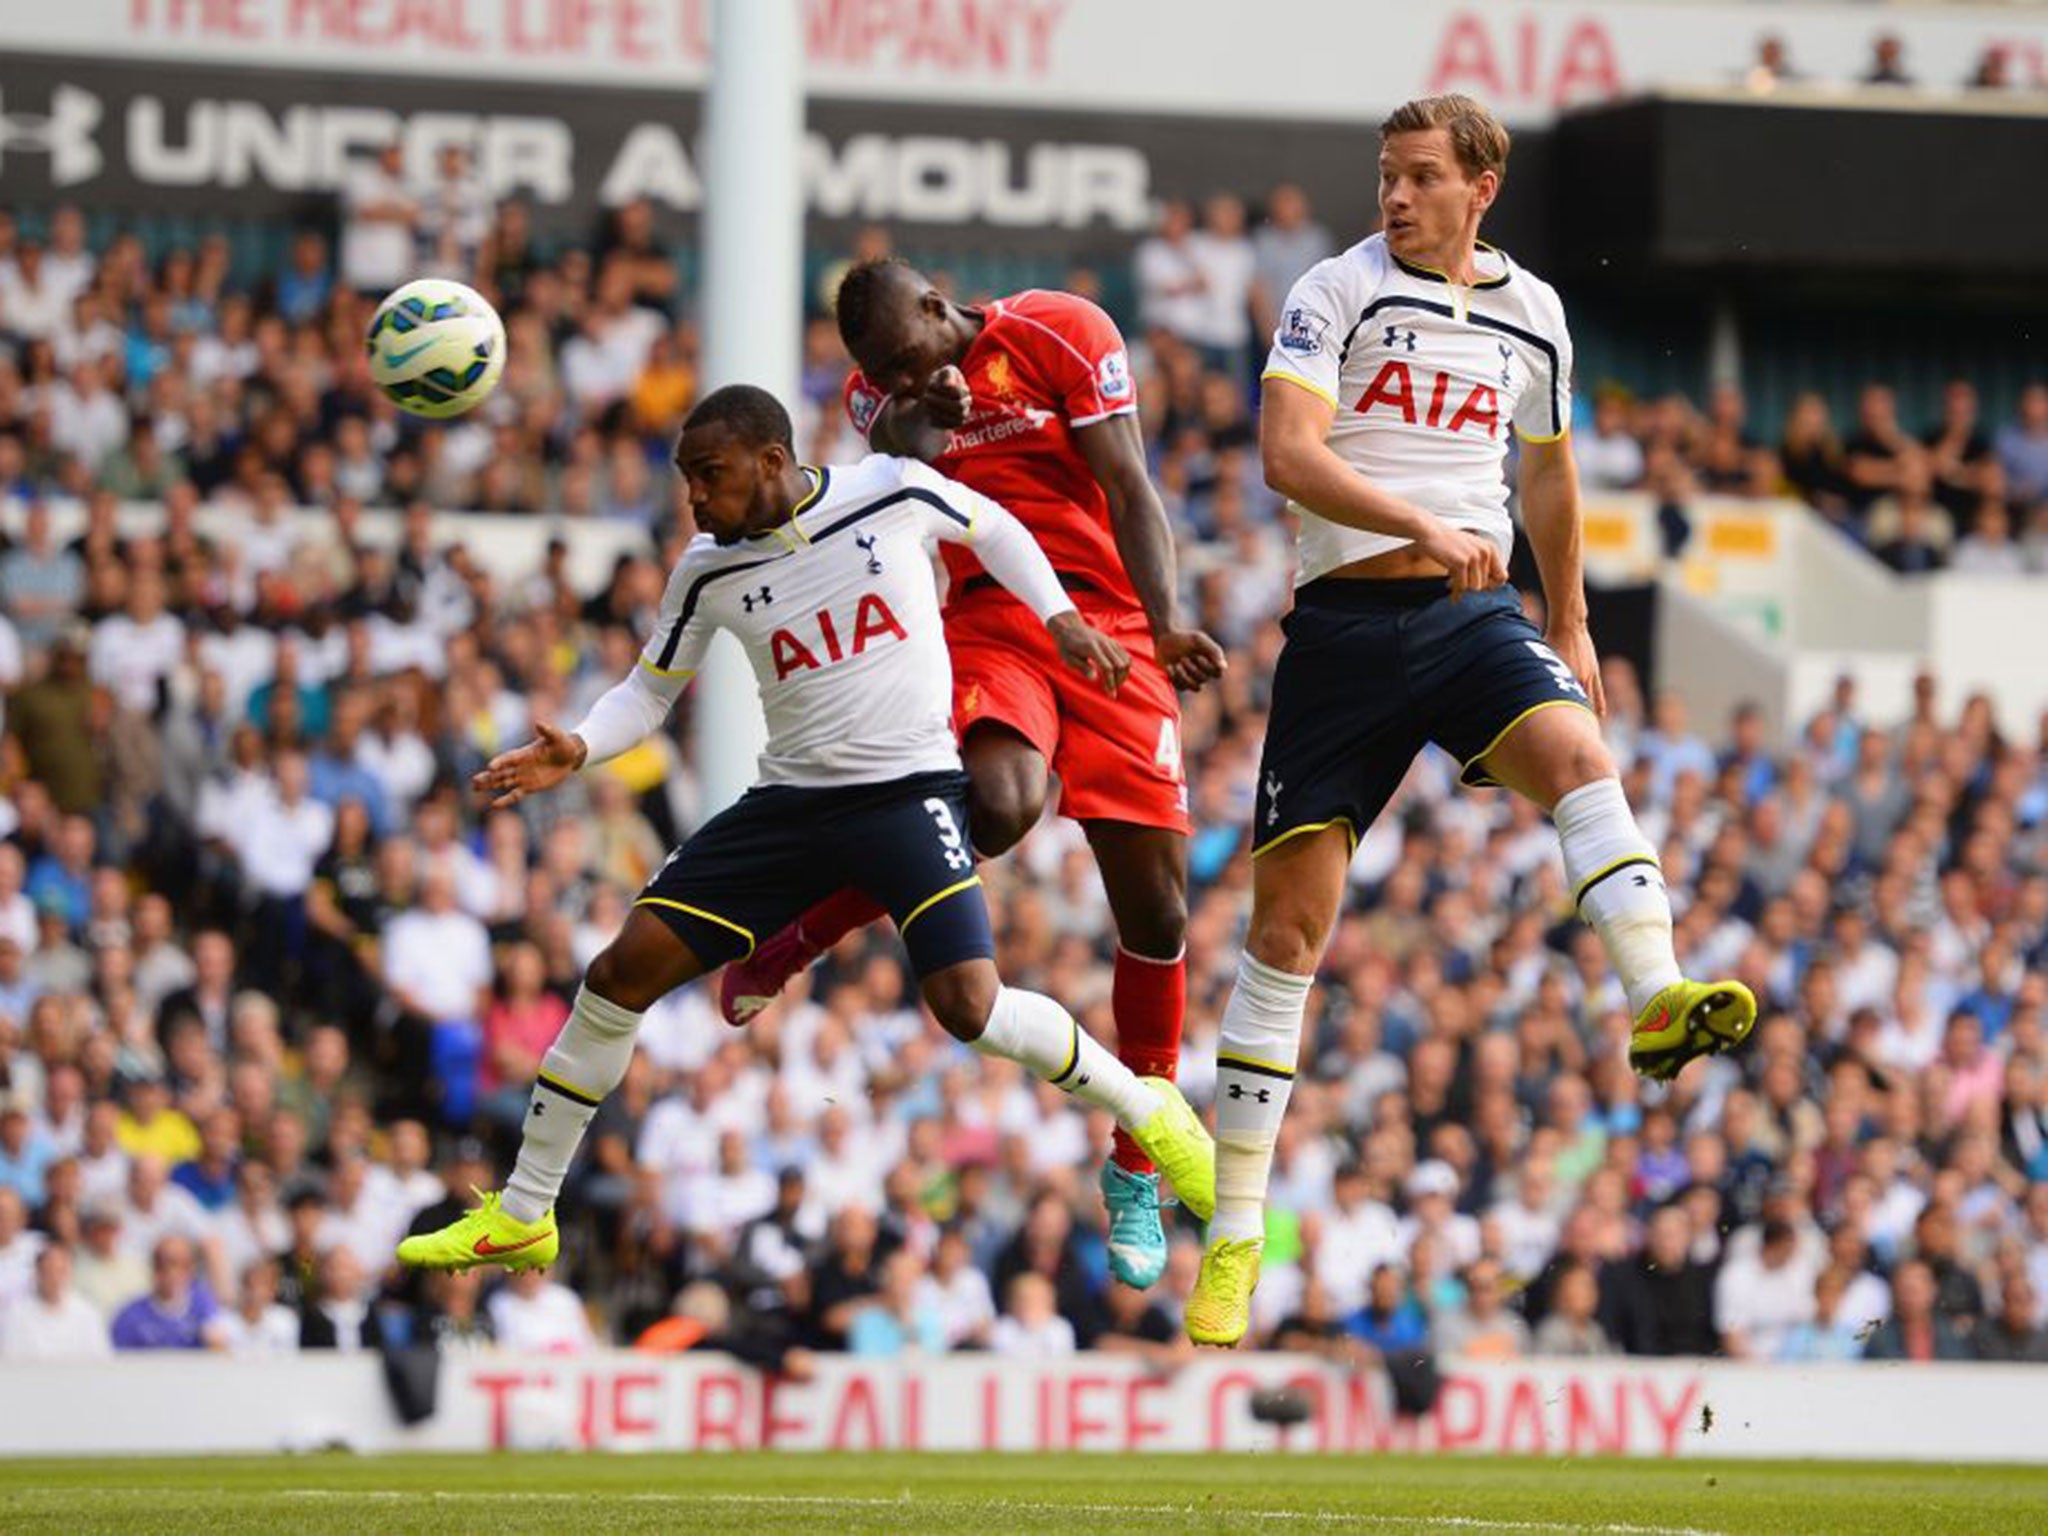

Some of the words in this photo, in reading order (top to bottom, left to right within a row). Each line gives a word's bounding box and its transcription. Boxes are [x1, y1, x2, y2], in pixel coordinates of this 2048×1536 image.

[1429, 11, 1622, 101] AIA
[600, 122, 1153, 229] AMOUR
[1354, 360, 1499, 440] AIA
[770, 593, 909, 682] AIA
[1154, 716, 1180, 780] 4
[923, 797, 961, 849] 3
